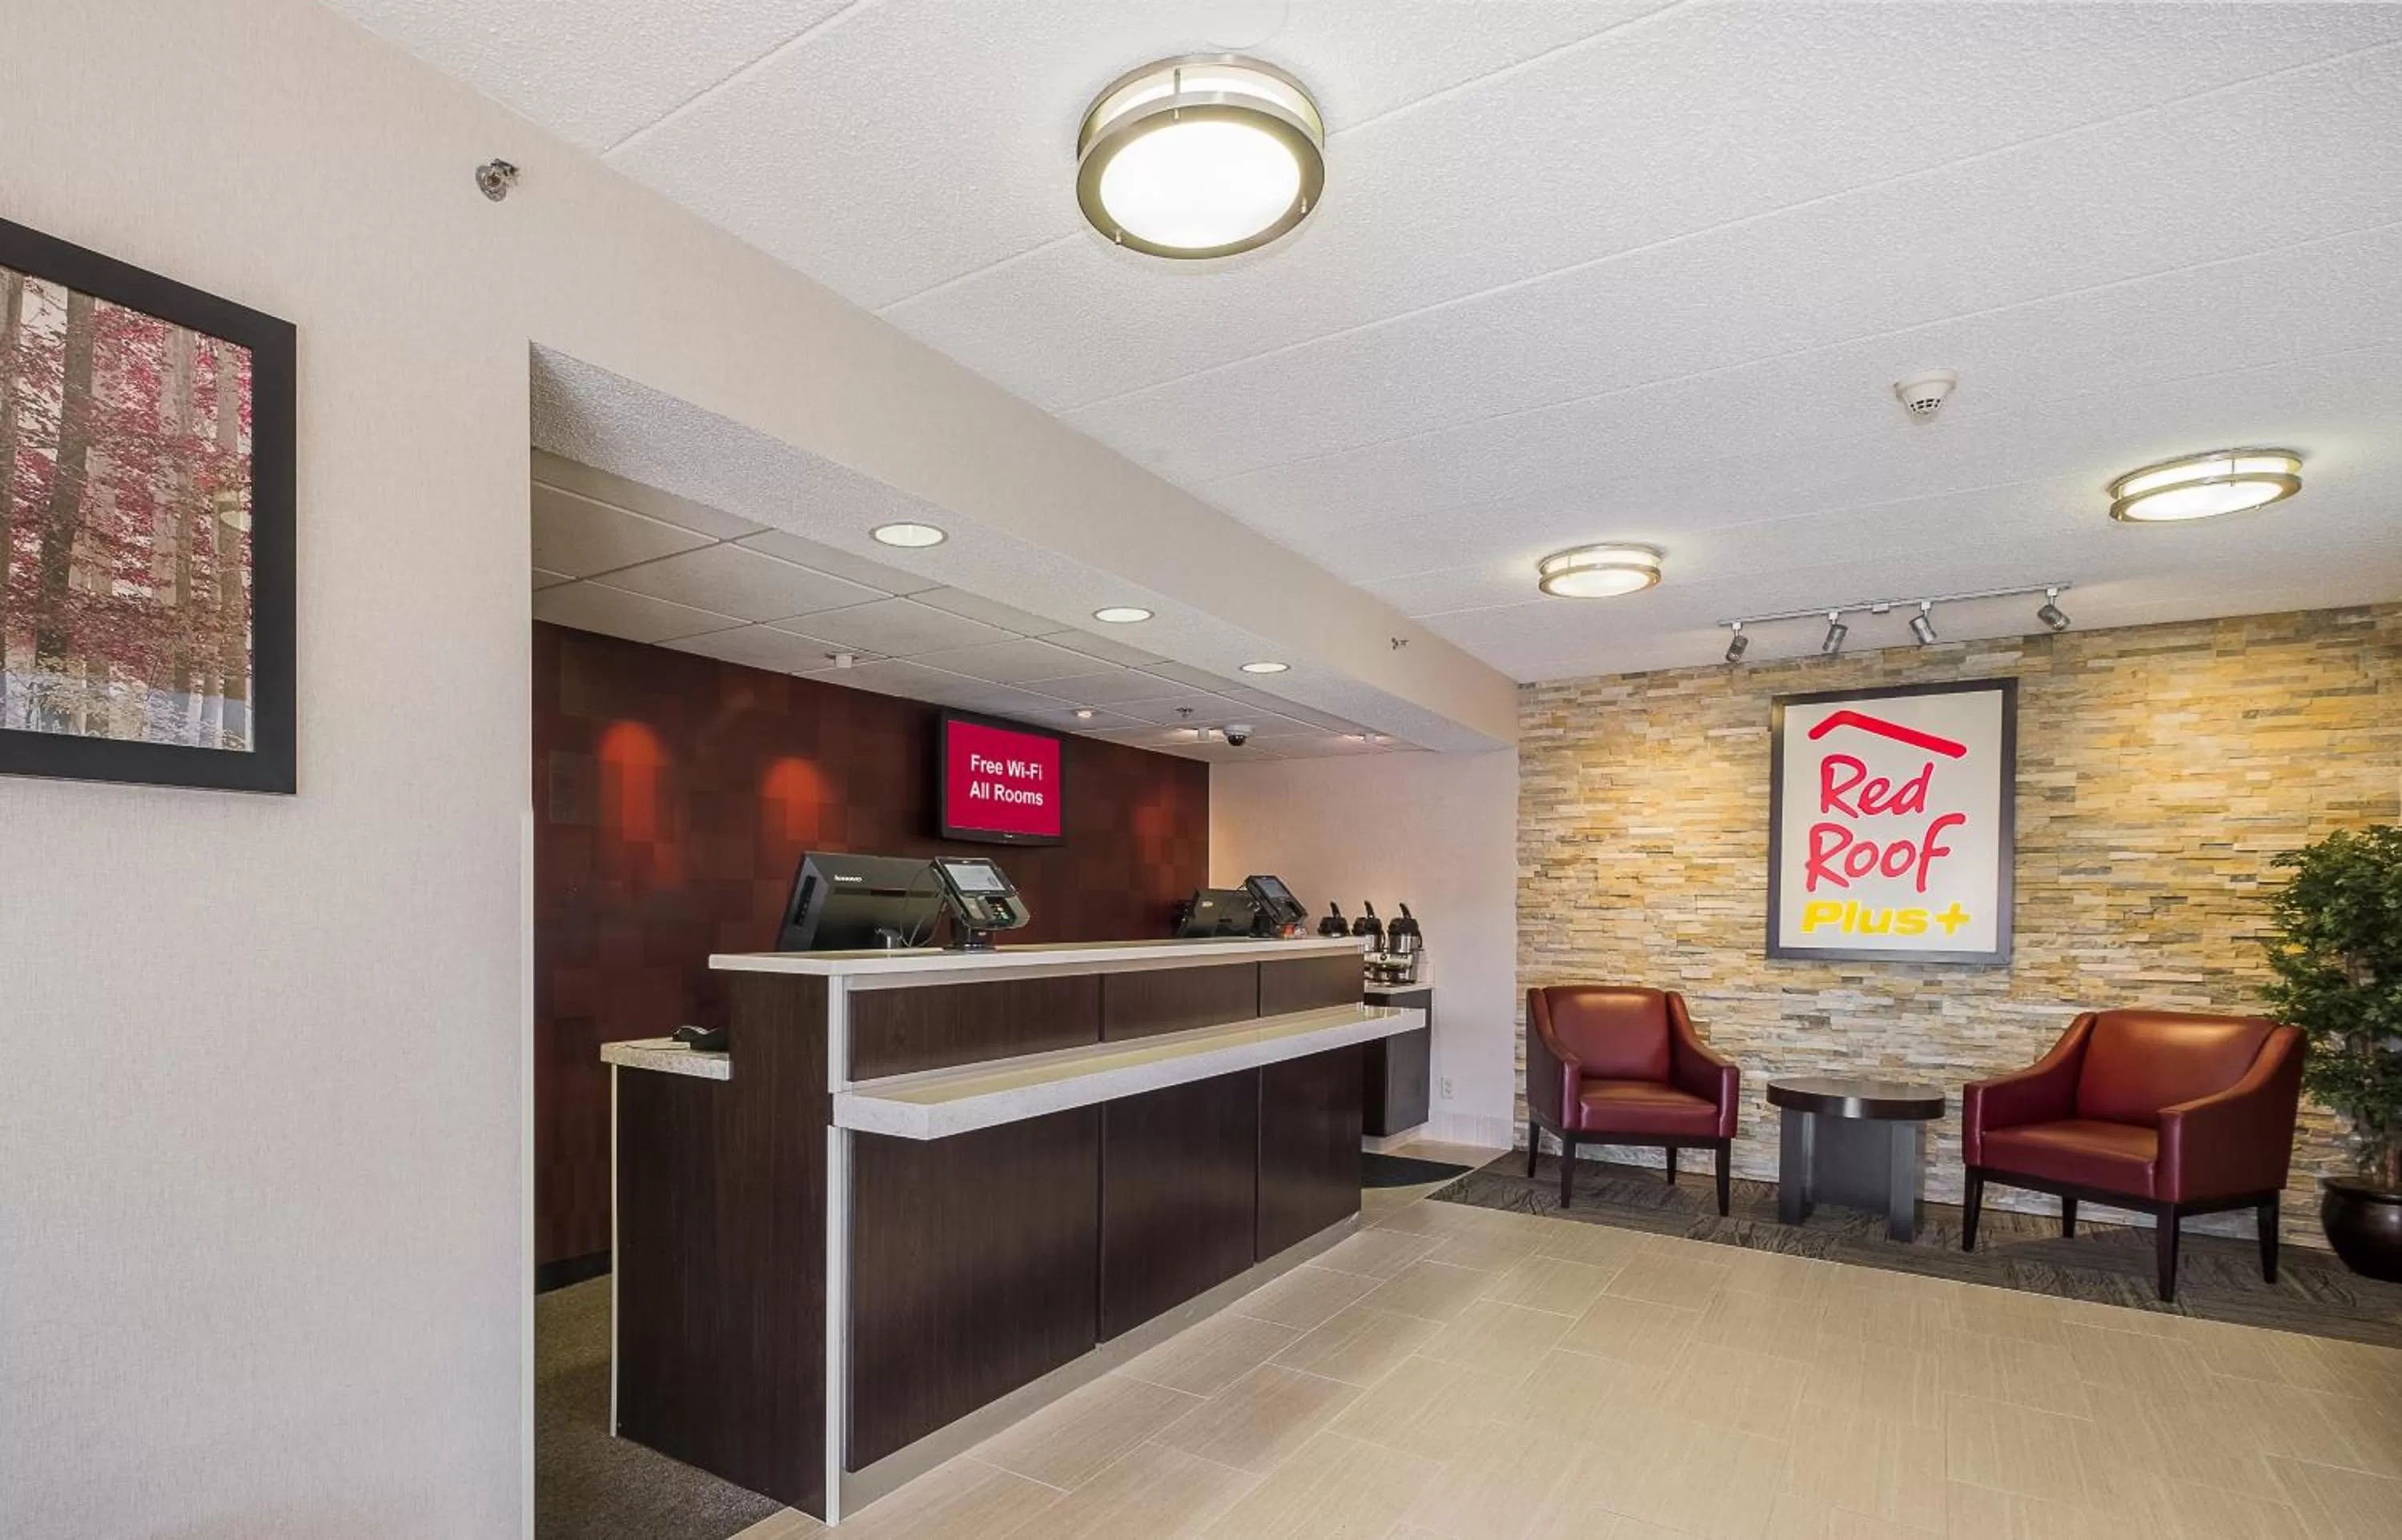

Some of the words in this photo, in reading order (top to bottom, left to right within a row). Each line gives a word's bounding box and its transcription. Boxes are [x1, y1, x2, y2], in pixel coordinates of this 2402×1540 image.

[970, 753, 1003, 775] Free
[1006, 760, 1042, 781] Wi-Fi
[1820, 753, 1934, 818] Red
[970, 780, 990, 800] All
[994, 784, 1044, 806] Rooms
[1805, 812, 1967, 893] Roof
